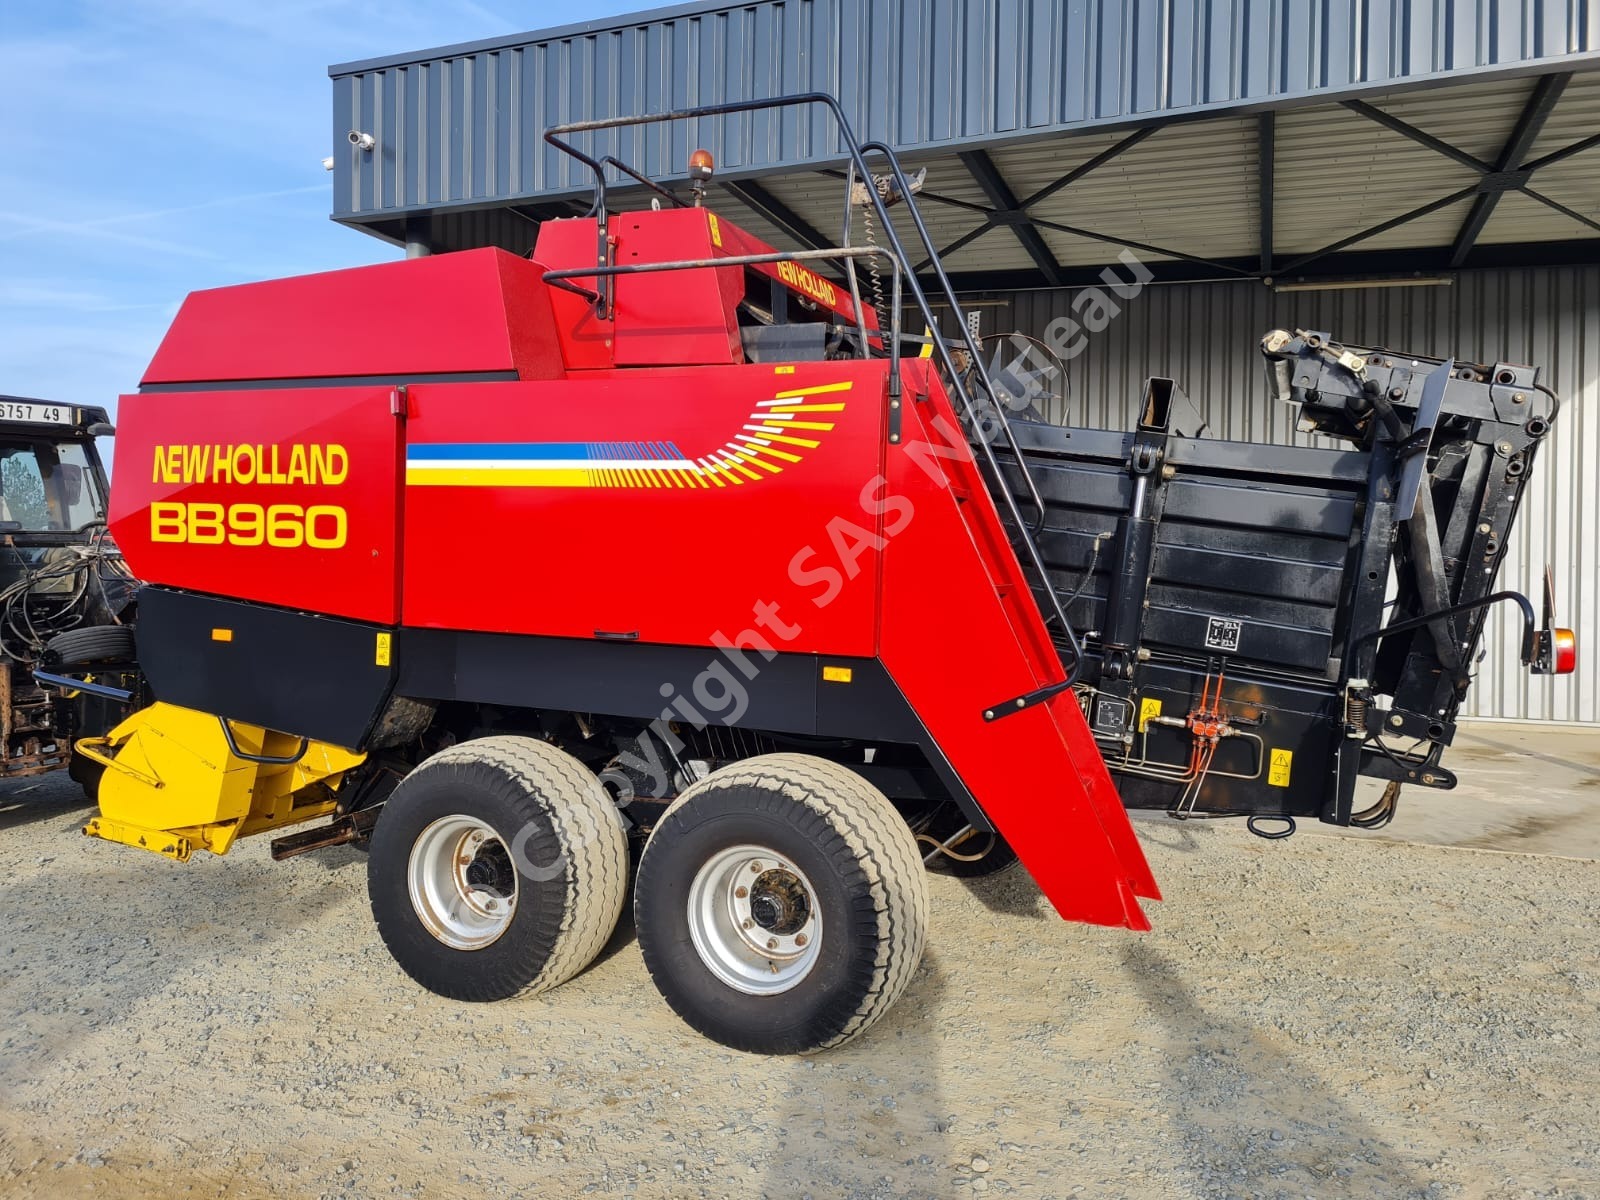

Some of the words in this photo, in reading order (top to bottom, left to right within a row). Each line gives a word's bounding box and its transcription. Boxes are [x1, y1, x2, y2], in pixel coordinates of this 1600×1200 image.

[796, 264, 836, 306] HOLLAND
[0, 403, 32, 419] 6757
[43, 407, 60, 421] 49
[152, 444, 210, 484] NEW
[212, 443, 349, 485] HOLLAND
[150, 501, 348, 549] BB960
